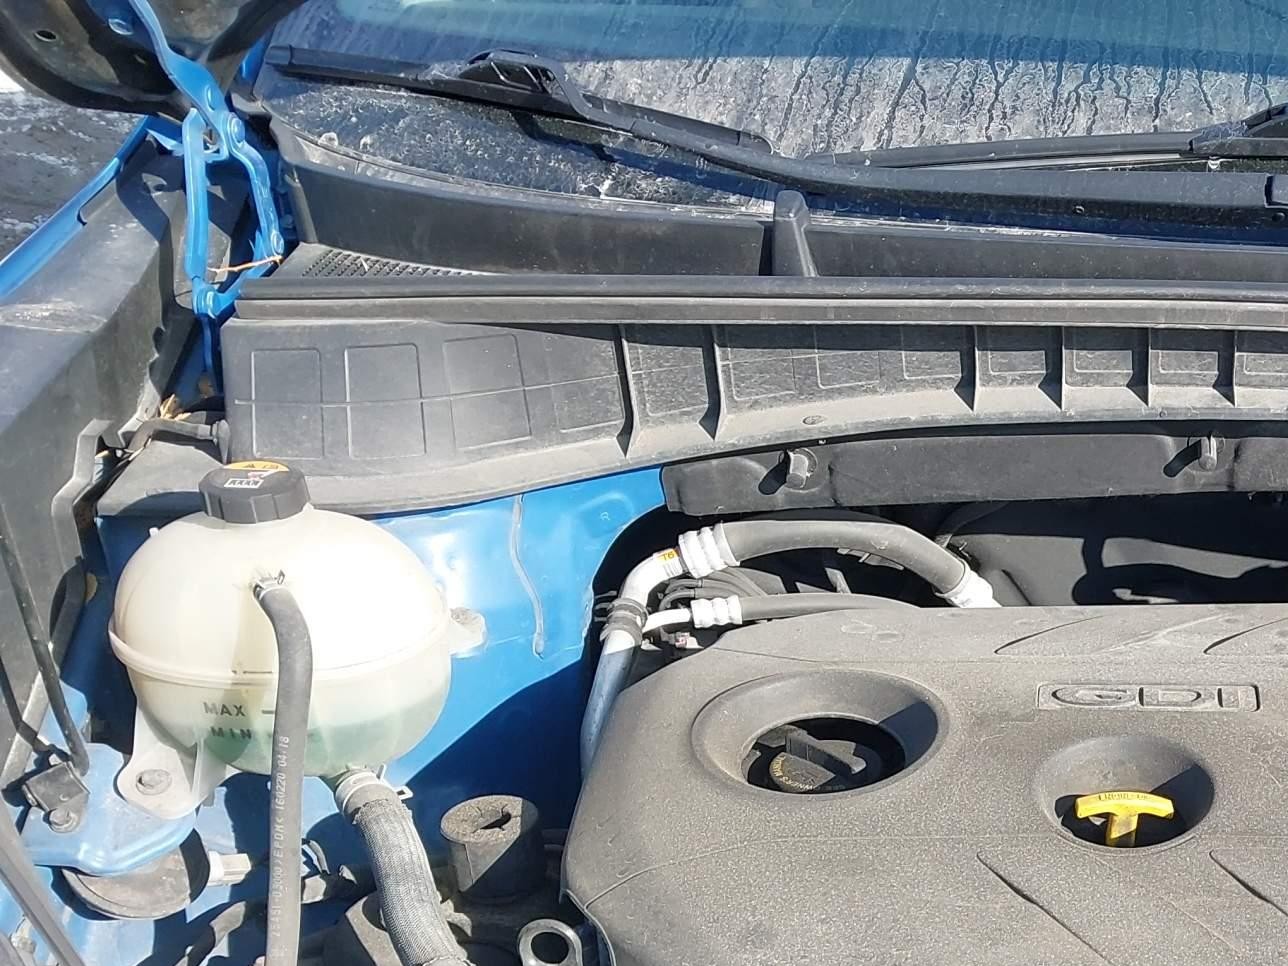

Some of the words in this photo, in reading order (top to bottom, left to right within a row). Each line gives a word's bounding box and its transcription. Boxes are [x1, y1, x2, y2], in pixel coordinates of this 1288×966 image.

[1050, 684, 1244, 708] GDI
[203, 702, 246, 717] MAX
[210, 726, 252, 740] MIN
